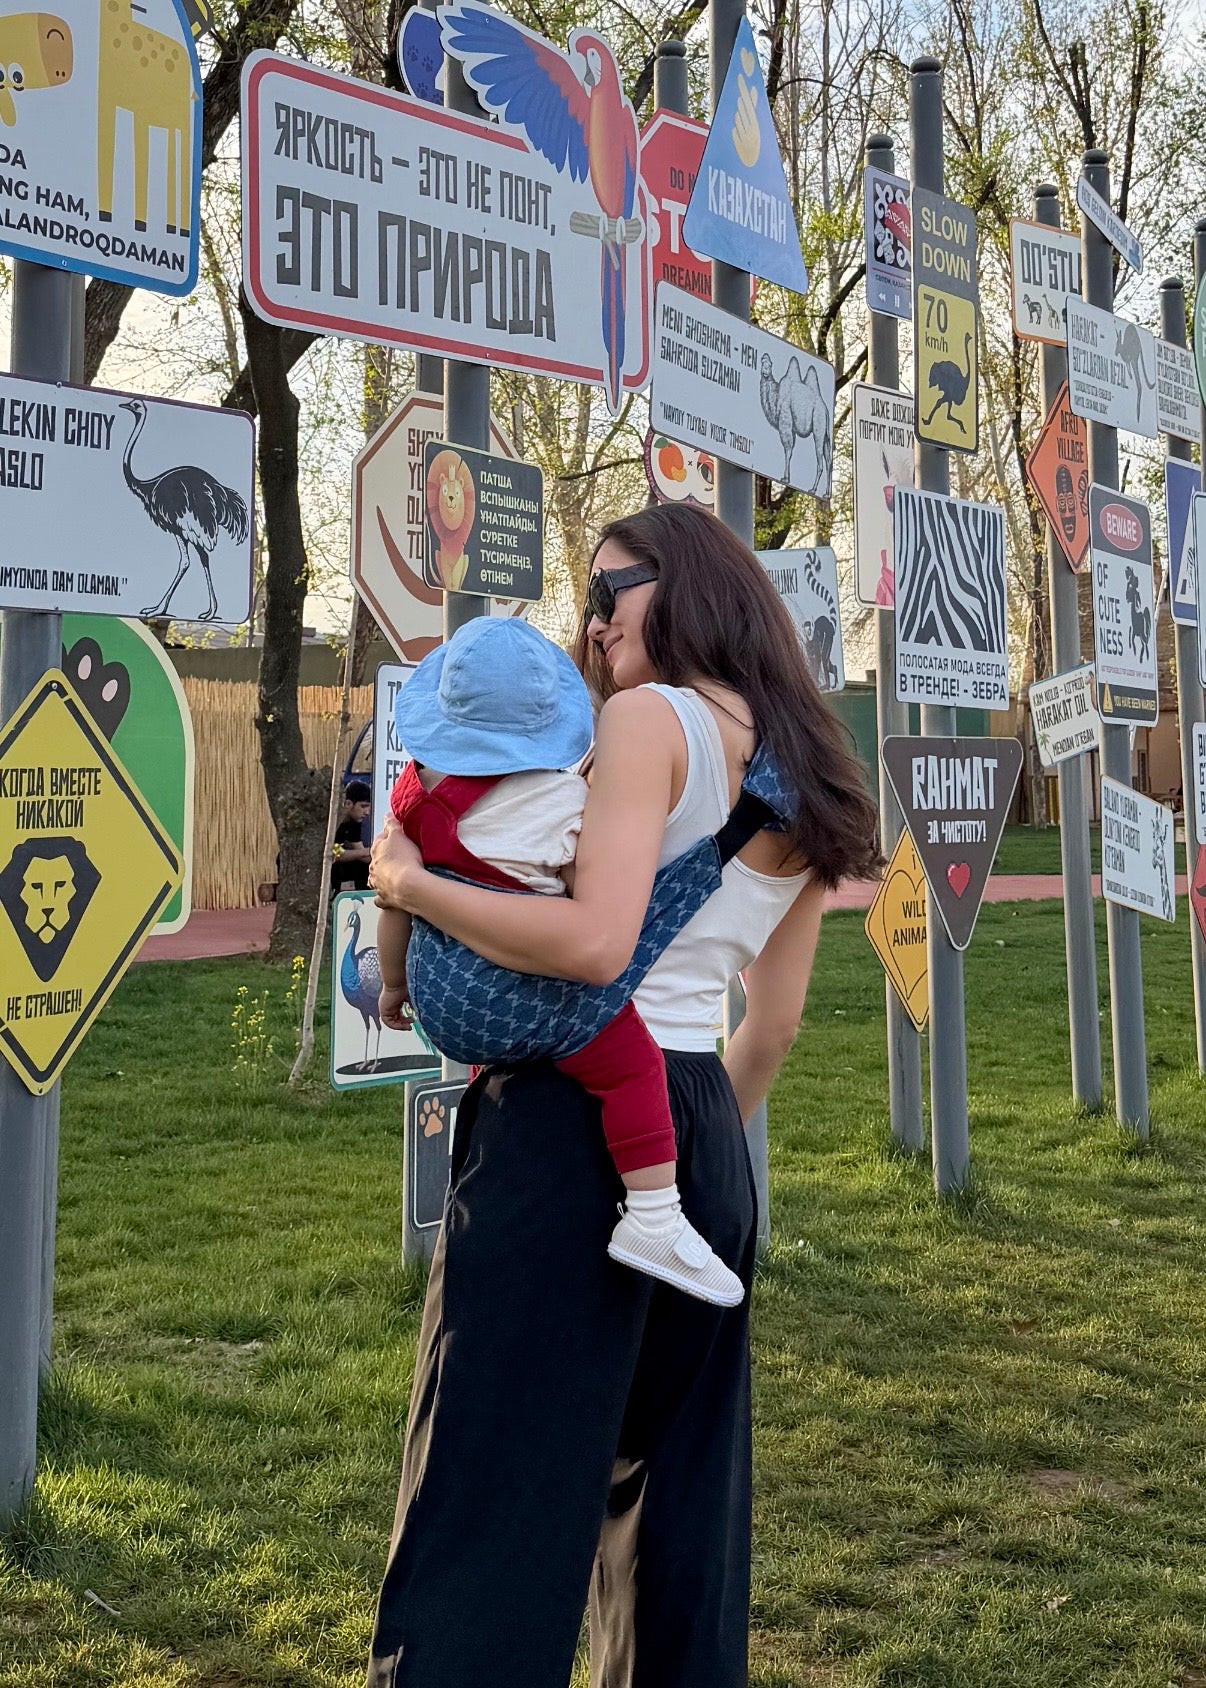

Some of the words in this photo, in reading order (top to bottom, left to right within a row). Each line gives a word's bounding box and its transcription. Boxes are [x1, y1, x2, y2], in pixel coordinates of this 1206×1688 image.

[274, 101, 383, 184] ЯРКОСТЬ
[418, 146, 458, 204] ЭТО
[466, 160, 492, 214] НЕ
[500, 170, 557, 236] ПОНТ,
[669, 166, 685, 191] DO
[35, 185, 90, 222] HAM,
[708, 165, 787, 245] КАЗАХСТАН
[0, 207, 185, 273] LANDROQDAMAN
[921, 206, 968, 247] SLOW
[275, 184, 359, 298] ЭТО
[378, 210, 557, 343] ПРИРОДА
[922, 242, 971, 284] DOWN
[662, 262, 712, 297] DREAMIN
[923, 293, 948, 334] 70
[661, 304, 683, 334] MENI
[685, 315, 731, 359] SHOSHIRMA
[741, 343, 758, 370] MEN
[925, 331, 949, 353] km/h
[660, 335, 698, 375] SAHRODA
[701, 353, 741, 393] SUZAMAN
[871, 397, 890, 420] ДАЖЕ
[64, 407, 116, 451] CHOY
[859, 418, 887, 444] ПОРТИТ
[1056, 436, 1084, 463] VILLAGE
[480, 471, 512, 489] ПАТША
[480, 490, 539, 514] ВСПЫШКАНЫ
[480, 530, 518, 548] СУРЕТКЕ
[1106, 511, 1138, 542] BEWARE
[52, 570, 74, 592] DAM
[1096, 561, 1109, 588] OF
[1098, 597, 1121, 624] CUTE
[1100, 628, 1123, 657] NESS
[899, 653, 949, 672] ПОЛОСАТАЯ
[950, 658, 975, 675] МОДА
[976, 661, 1006, 679] ВСЕГДА
[900, 673, 908, 692] В
[910, 674, 960, 699] ТРЕНДЕ!
[972, 680, 1007, 702] ЗЕБРА
[1035, 698, 1074, 731] HARAKAT
[0, 767, 45, 797] КОГДА
[50, 767, 101, 797] ВМЕСТЕ
[911, 755, 998, 811] RAHMAT
[16, 797, 84, 829] НИКАКОЙ
[927, 820, 939, 844] ЗА
[941, 819, 987, 843] ЧИСТОТУ!
[892, 925, 928, 948] ANIMA
[7, 996, 22, 1021] НЕ
[25, 988, 82, 1019] СТРАШЕН!
